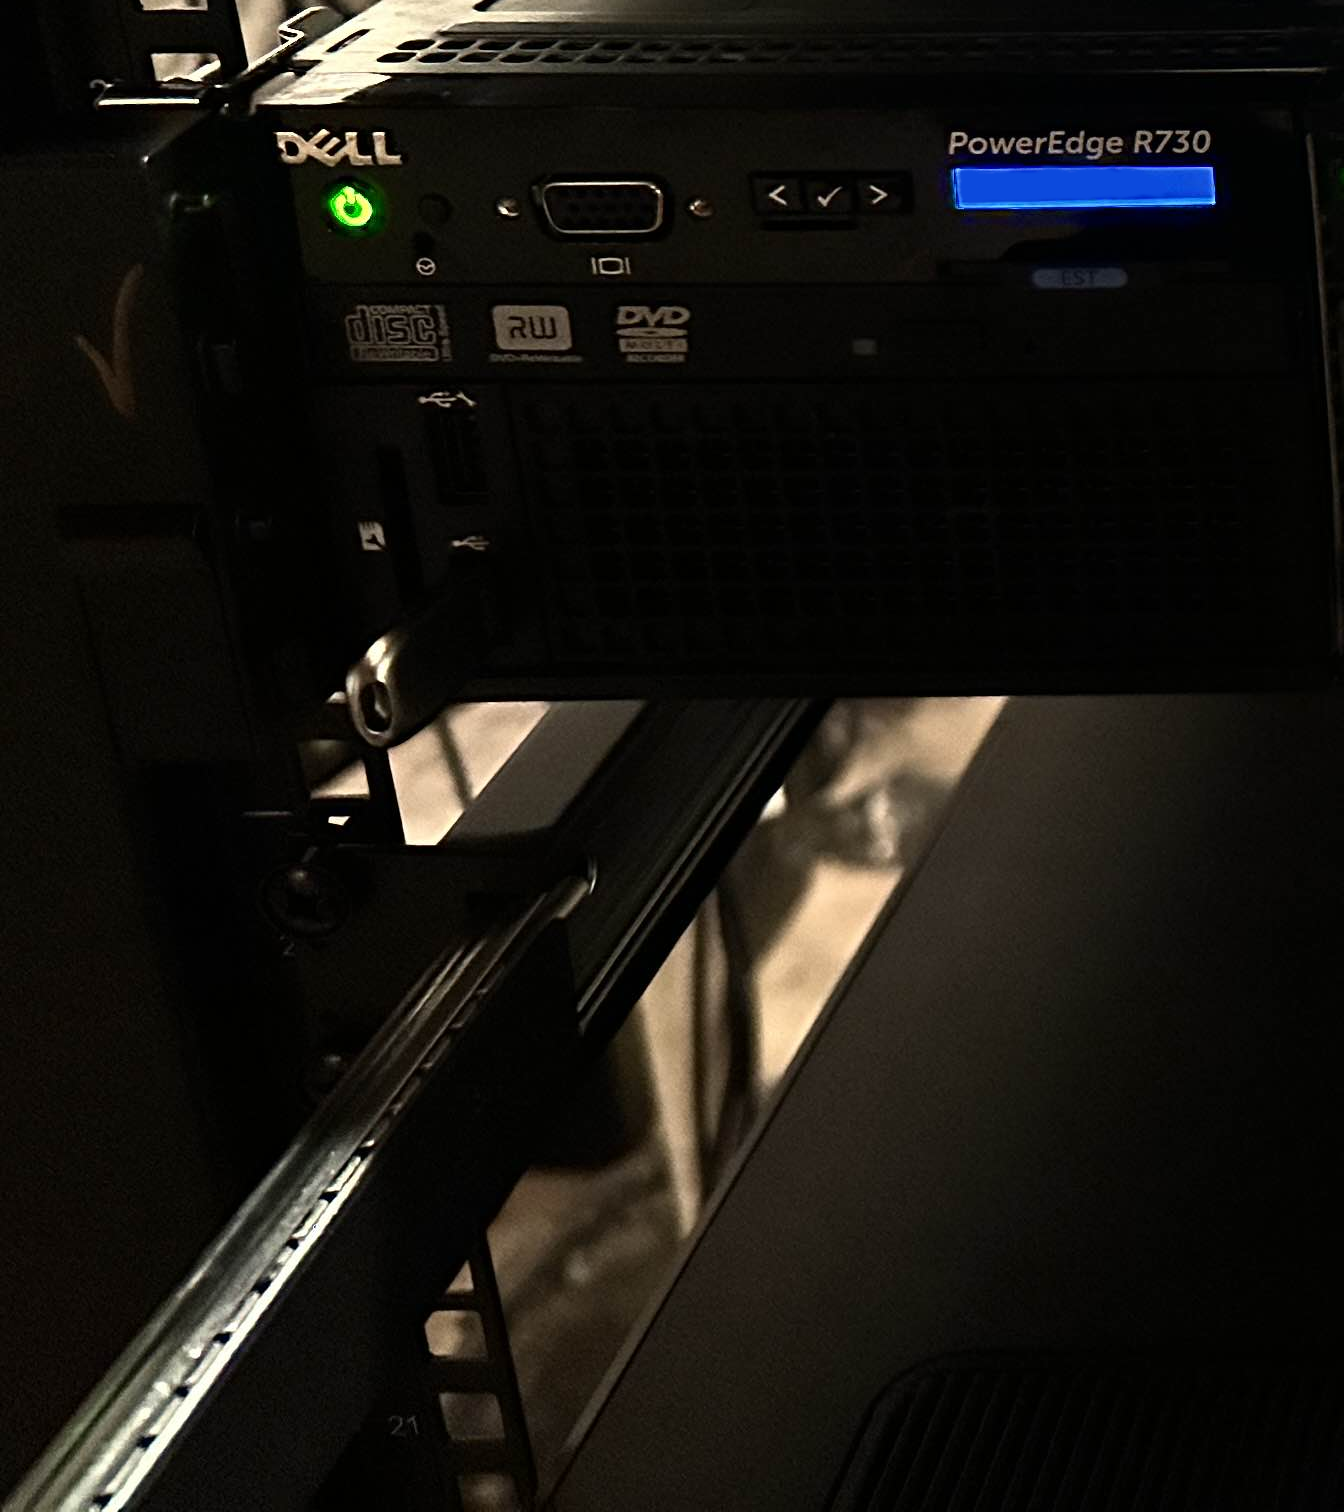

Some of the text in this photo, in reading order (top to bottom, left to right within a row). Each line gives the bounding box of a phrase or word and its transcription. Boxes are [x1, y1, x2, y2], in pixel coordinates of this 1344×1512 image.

[275, 128, 401, 166] DELL
[948, 129, 1212, 160] PowerEdge R730
[1061, 269, 1100, 286] EST
[507, 315, 557, 340] RW
[616, 305, 691, 327] DVD
[388, 1414, 419, 1436] 21
